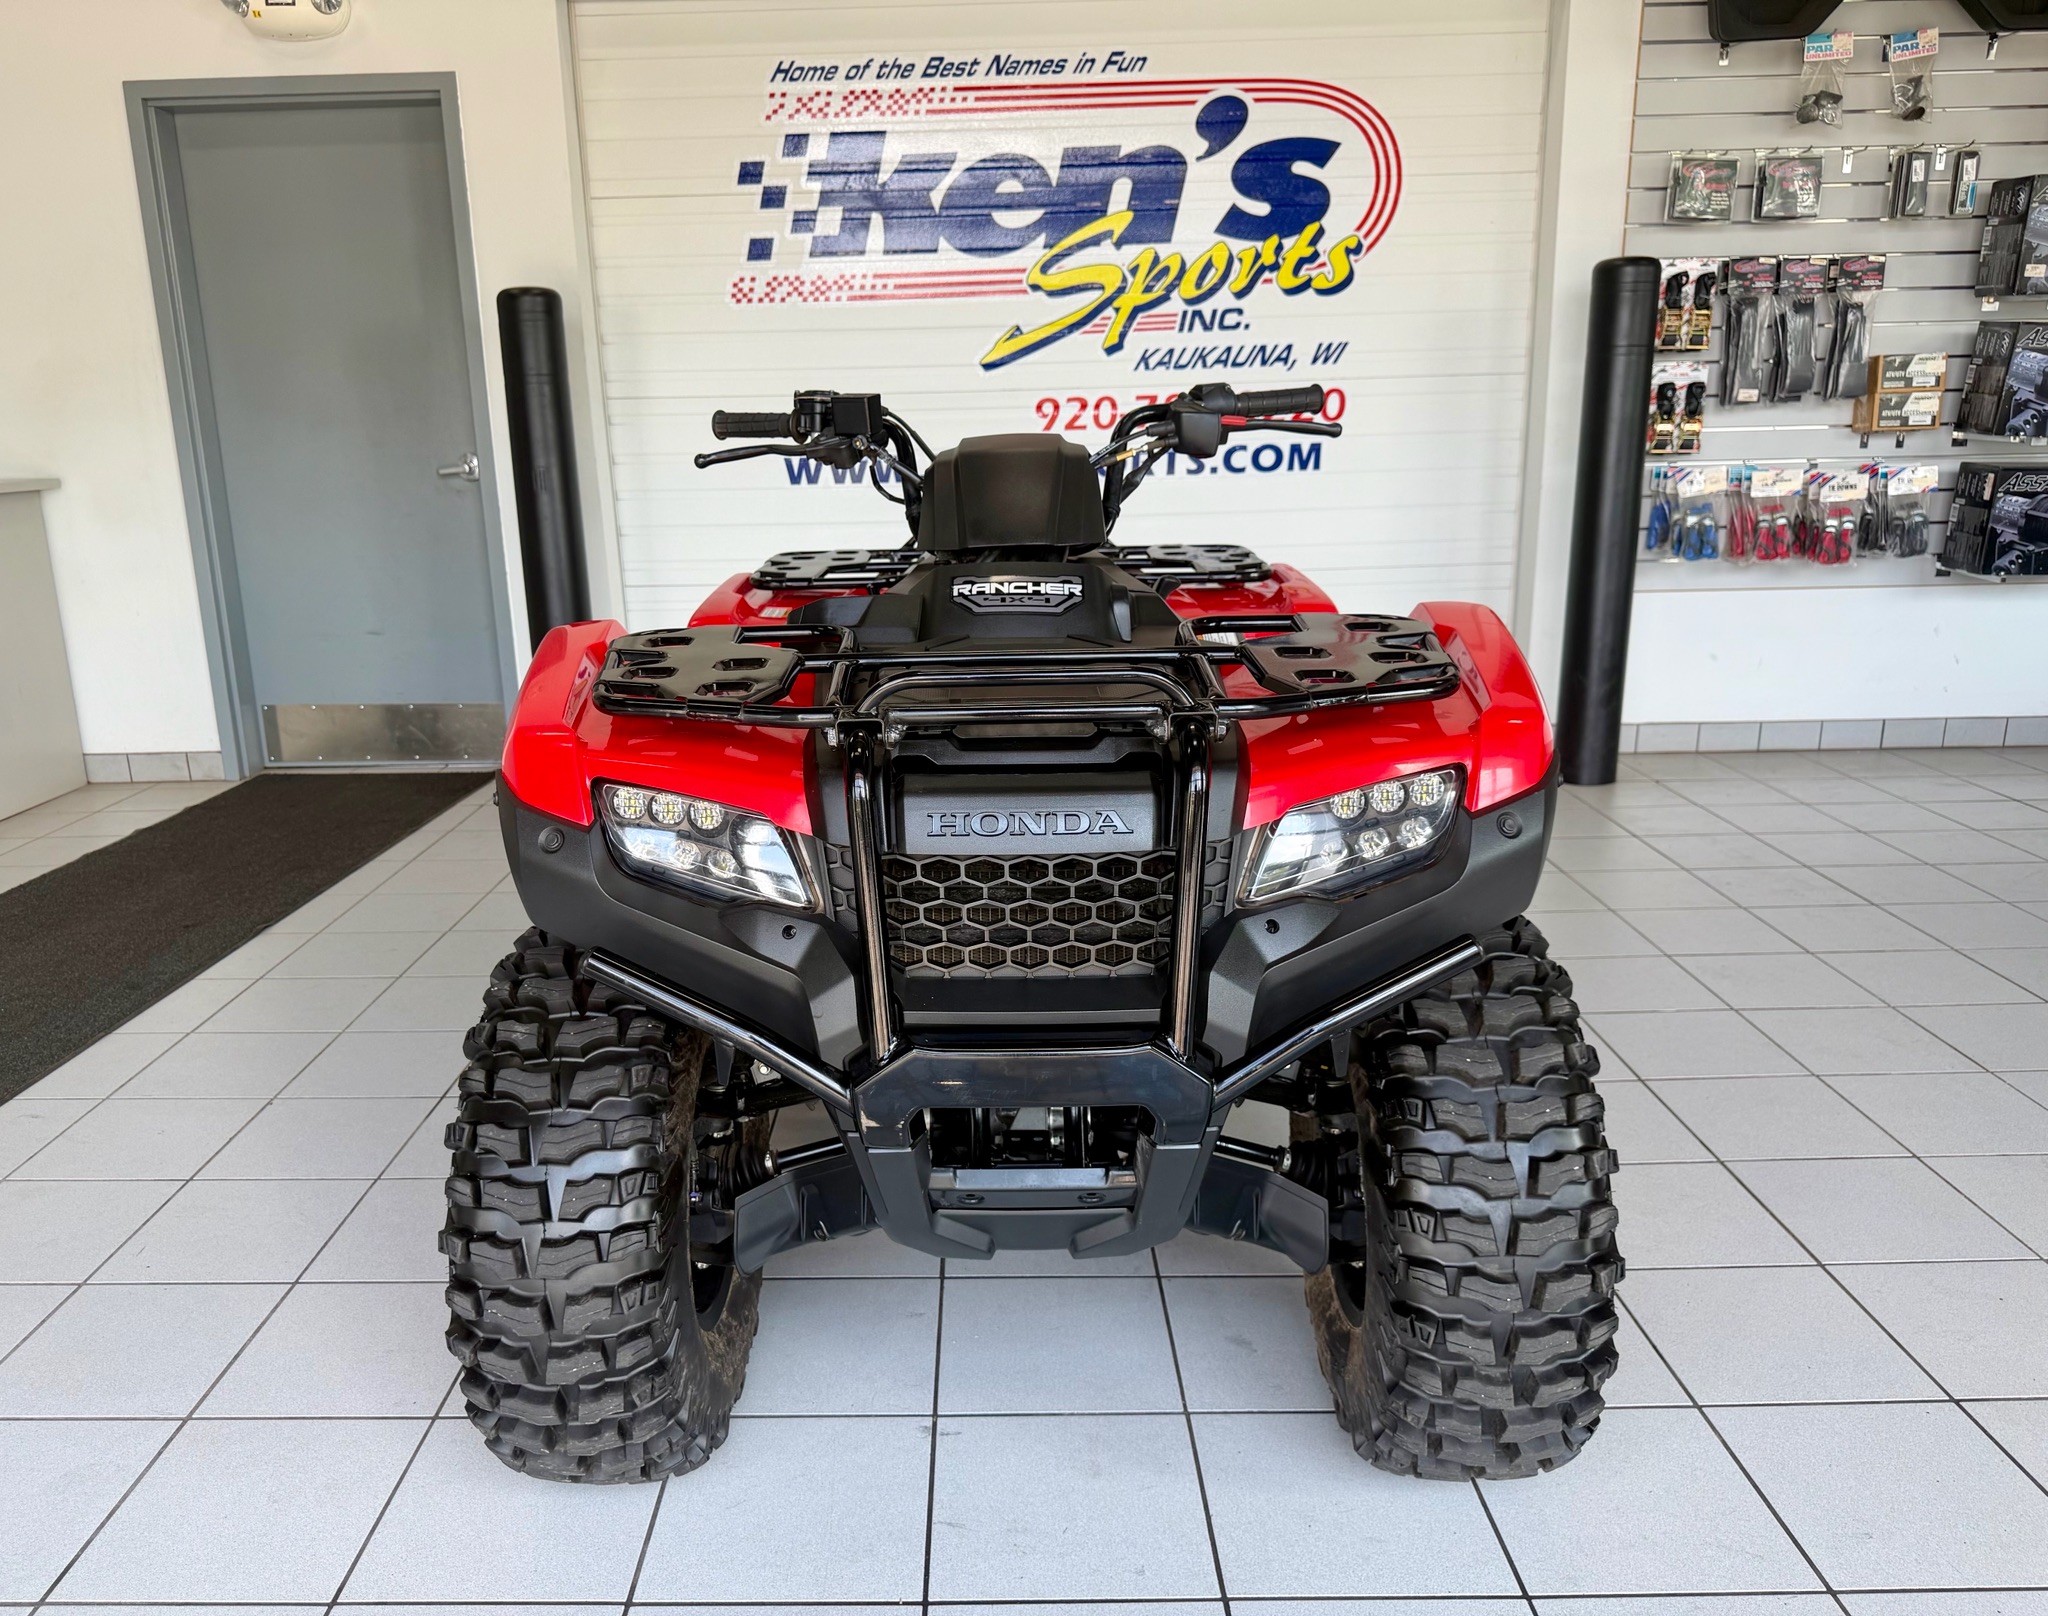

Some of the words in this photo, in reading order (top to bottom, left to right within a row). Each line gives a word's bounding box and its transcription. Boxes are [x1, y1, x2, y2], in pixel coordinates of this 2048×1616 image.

[1806, 51, 1852, 60] UNLIMITED
[1893, 47, 1937, 59] UNLIMITED
[770, 60, 839, 83] Home
[844, 58, 874, 81] of
[876, 57, 915, 80] the
[920, 56, 980, 78] Best
[985, 54, 1068, 77] Names
[1073, 52, 1096, 74] in
[1101, 51, 1148, 73] Fun
[978, 210, 1364, 371] Sports
[1178, 307, 1250, 333] INC.
[1133, 343, 1297, 372] KAUKAUNA,
[1310, 340, 1349, 366] WI
[951, 581, 1083, 597] RANCHER
[926, 809, 1135, 837] HONDA
